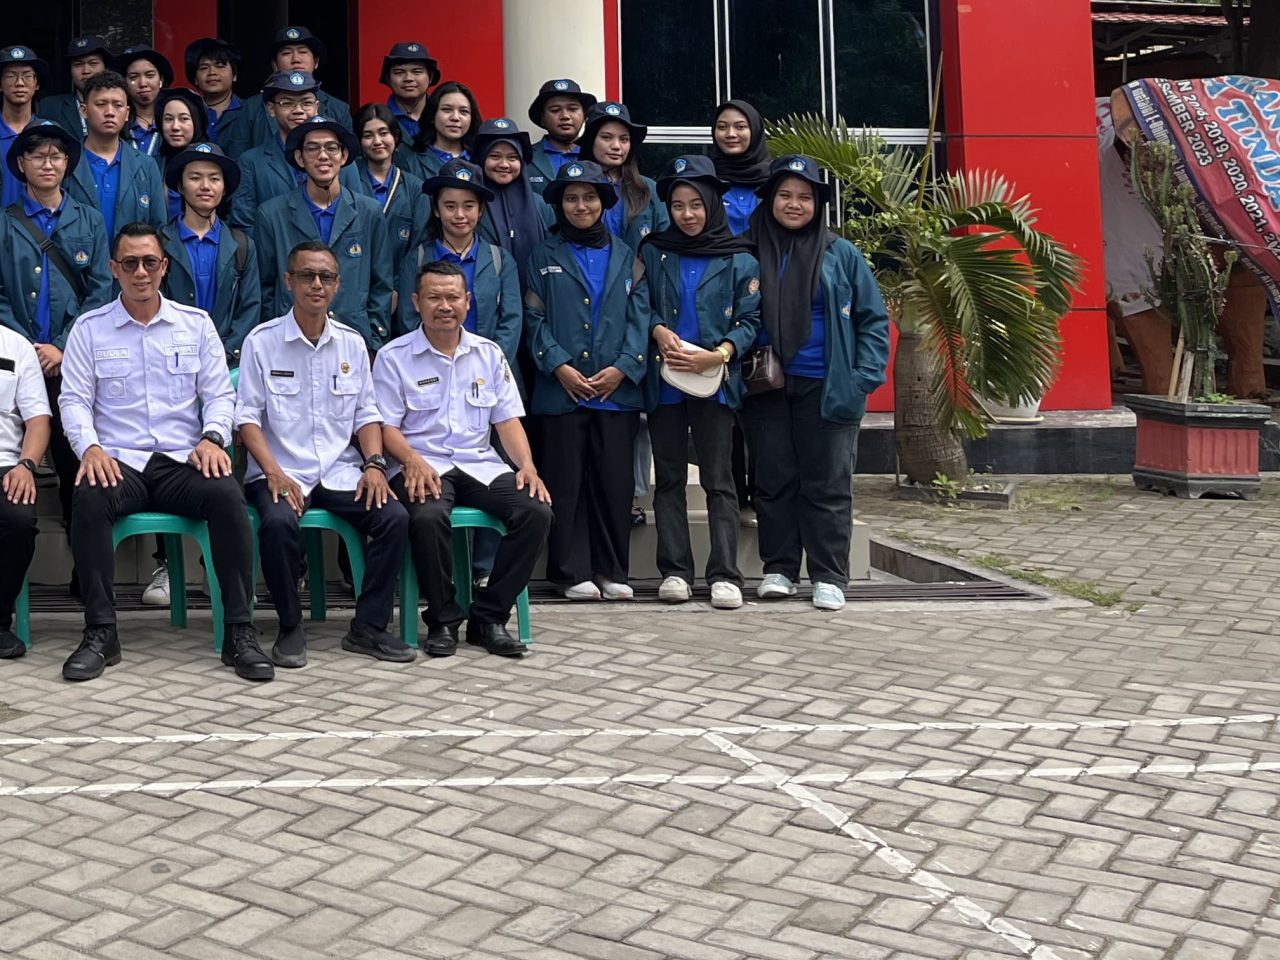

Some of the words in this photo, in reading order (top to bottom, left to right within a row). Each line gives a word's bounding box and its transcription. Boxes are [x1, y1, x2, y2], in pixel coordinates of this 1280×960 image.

[1187, 133, 1213, 166] 2023
[1203, 120, 1230, 158] 2019,
[1221, 158, 1248, 196] 2020,
[1239, 194, 1268, 233] 2021,
